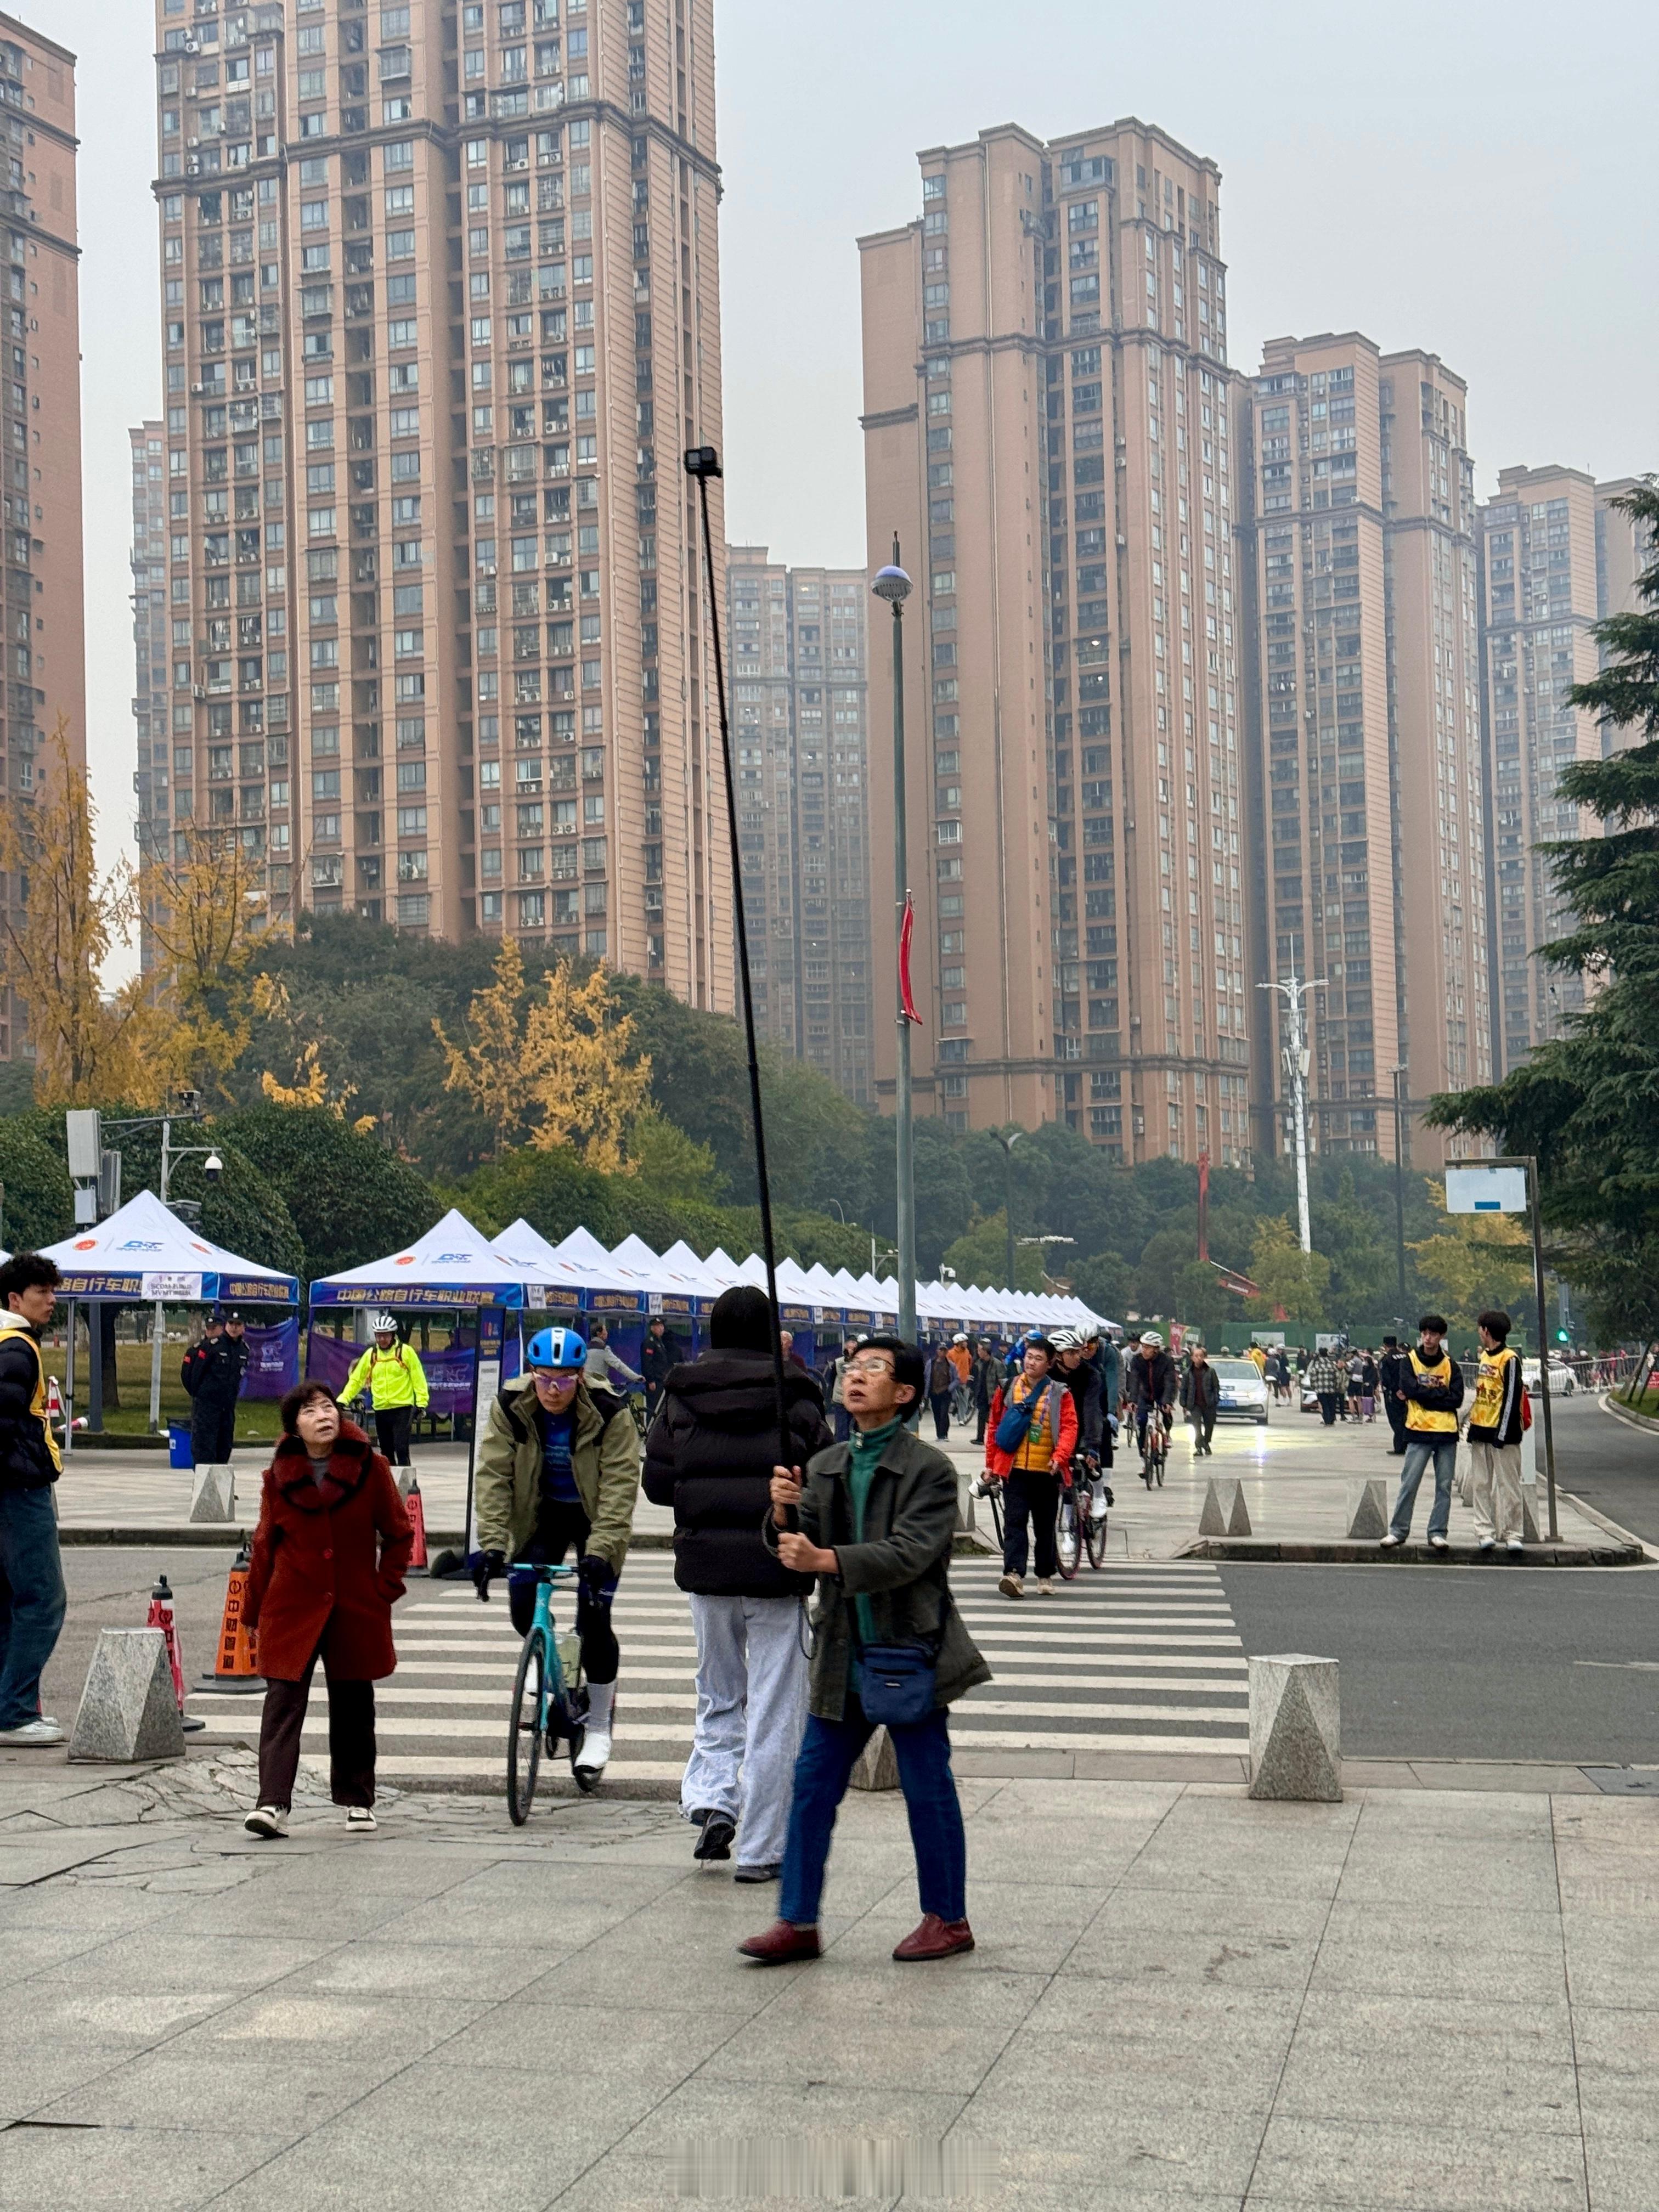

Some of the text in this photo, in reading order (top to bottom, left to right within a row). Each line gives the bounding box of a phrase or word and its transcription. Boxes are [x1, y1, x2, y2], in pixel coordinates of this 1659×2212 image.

[336, 1288, 495, 1304] 中国公路自行车职业联赛
